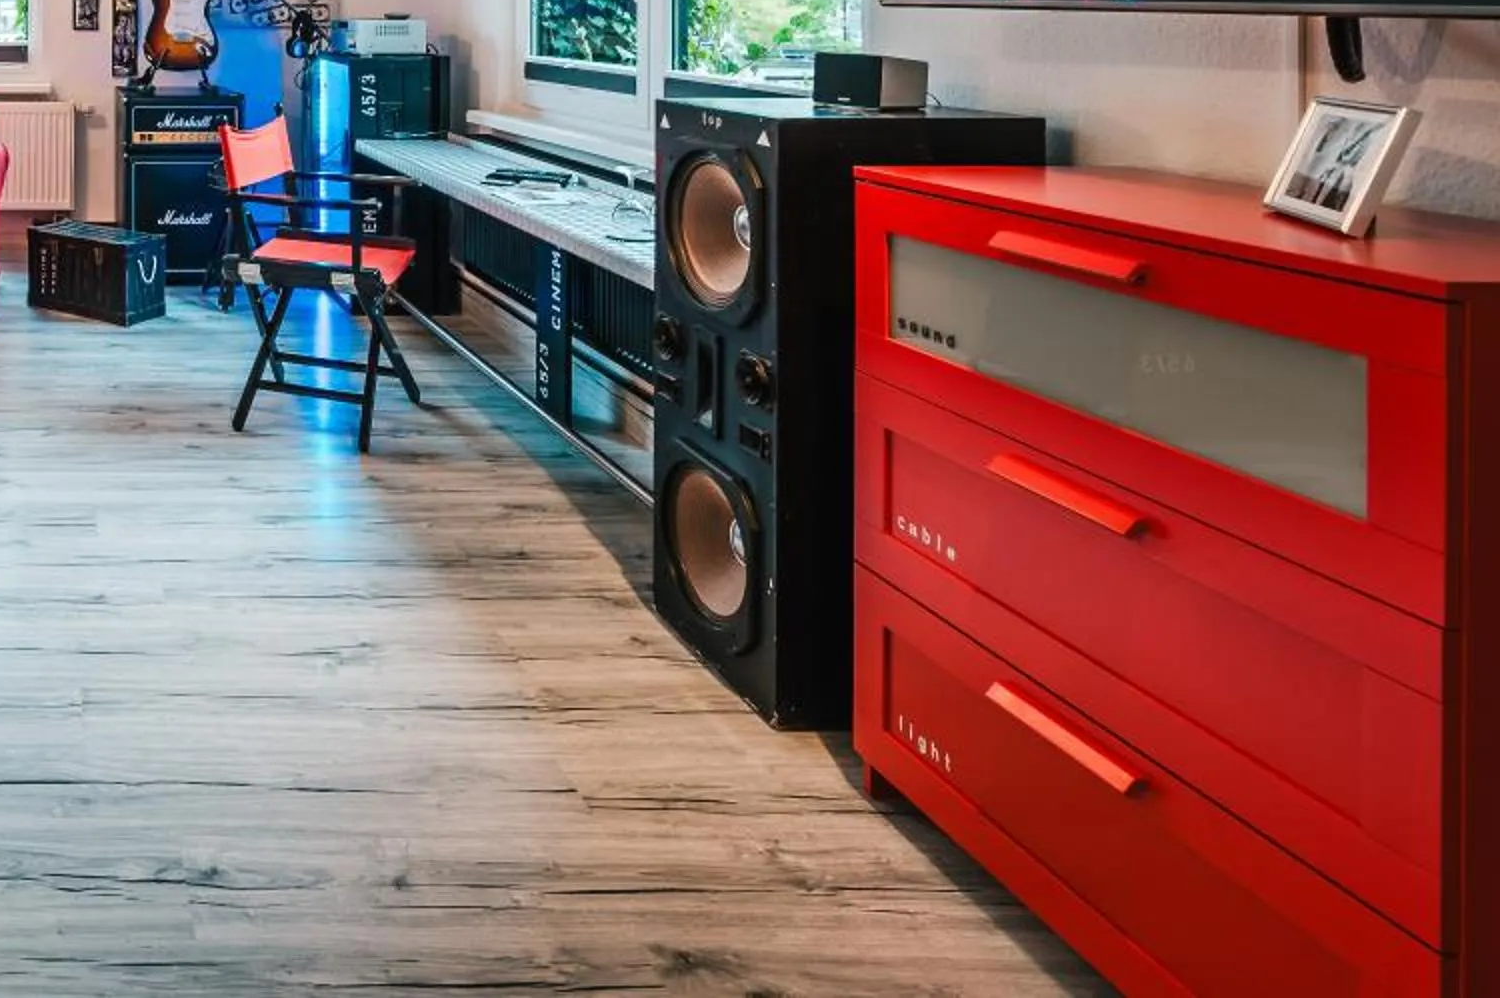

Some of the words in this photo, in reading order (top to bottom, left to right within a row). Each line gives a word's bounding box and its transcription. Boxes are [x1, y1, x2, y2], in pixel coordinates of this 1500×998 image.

[361, 74, 377, 117] 65/3
[156, 111, 213, 128] Marshall
[157, 209, 213, 225] Marshall
[551, 248, 562, 330] CINEM
[897, 317, 956, 349] sound
[539, 342, 549, 398] 65/3
[897, 514, 956, 562] cable
[899, 713, 950, 772] light
